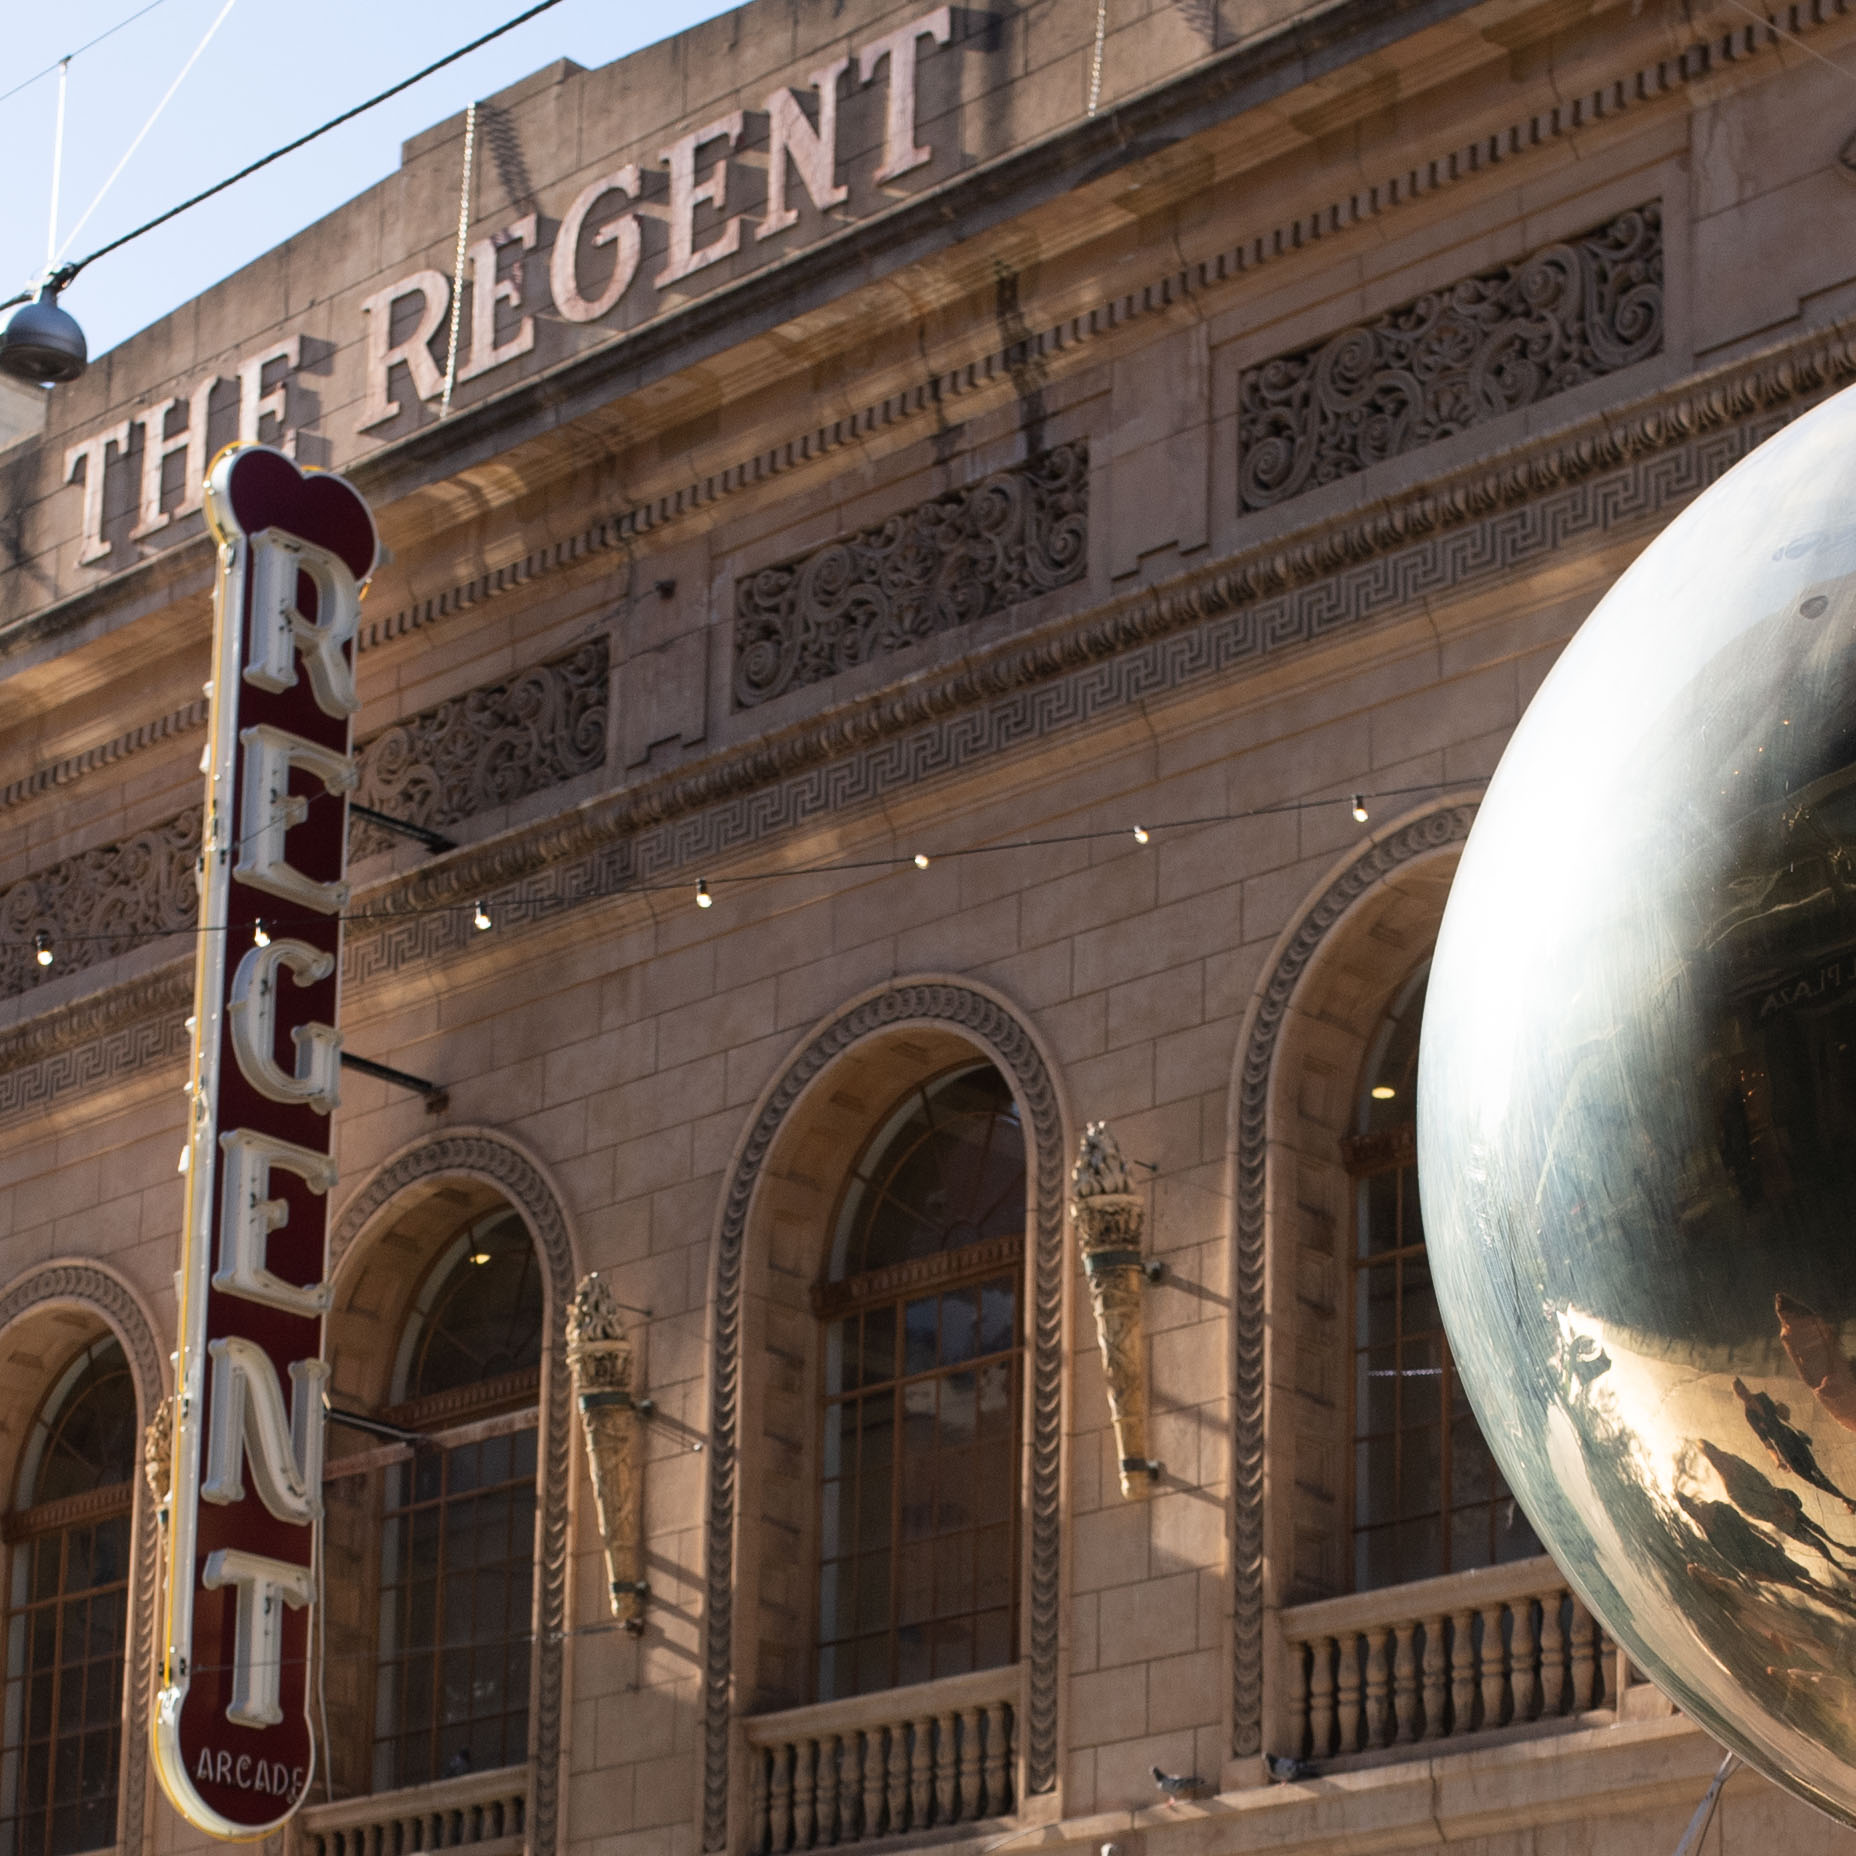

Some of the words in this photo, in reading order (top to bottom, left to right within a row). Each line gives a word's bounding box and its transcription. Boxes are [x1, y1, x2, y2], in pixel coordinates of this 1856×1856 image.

[63, 334, 302, 565] THE
[356, 4, 951, 435] REGENT
[202, 525, 362, 1729] REGENT
[195, 1746, 304, 1802] ARCADE
